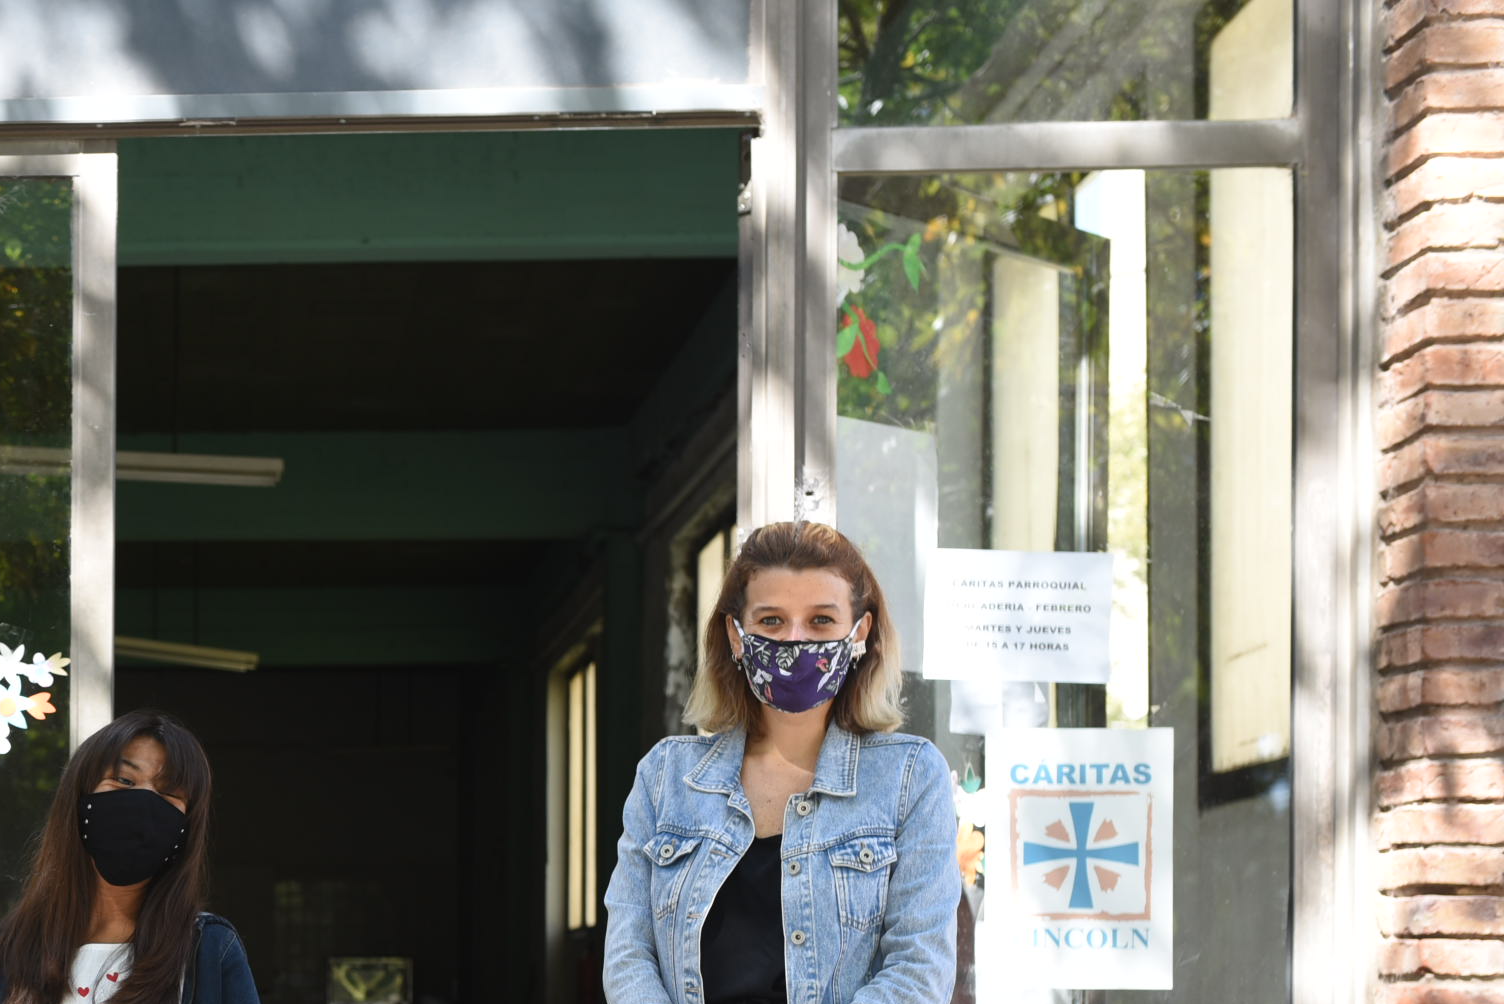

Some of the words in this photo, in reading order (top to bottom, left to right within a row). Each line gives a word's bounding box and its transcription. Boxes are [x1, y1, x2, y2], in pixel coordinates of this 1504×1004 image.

[1007, 579, 1087, 591] PARROQUIAL
[1035, 603, 1093, 614] FEBRERO
[1015, 624, 1024, 634] Y
[1026, 625, 1072, 635] JUEVES
[1001, 642, 1009, 651] A
[1013, 642, 1026, 651] 17
[1029, 642, 1070, 652] HORAS
[1010, 760, 1152, 785] CÁRITAS
[1030, 926, 1152, 951] INCOLN
